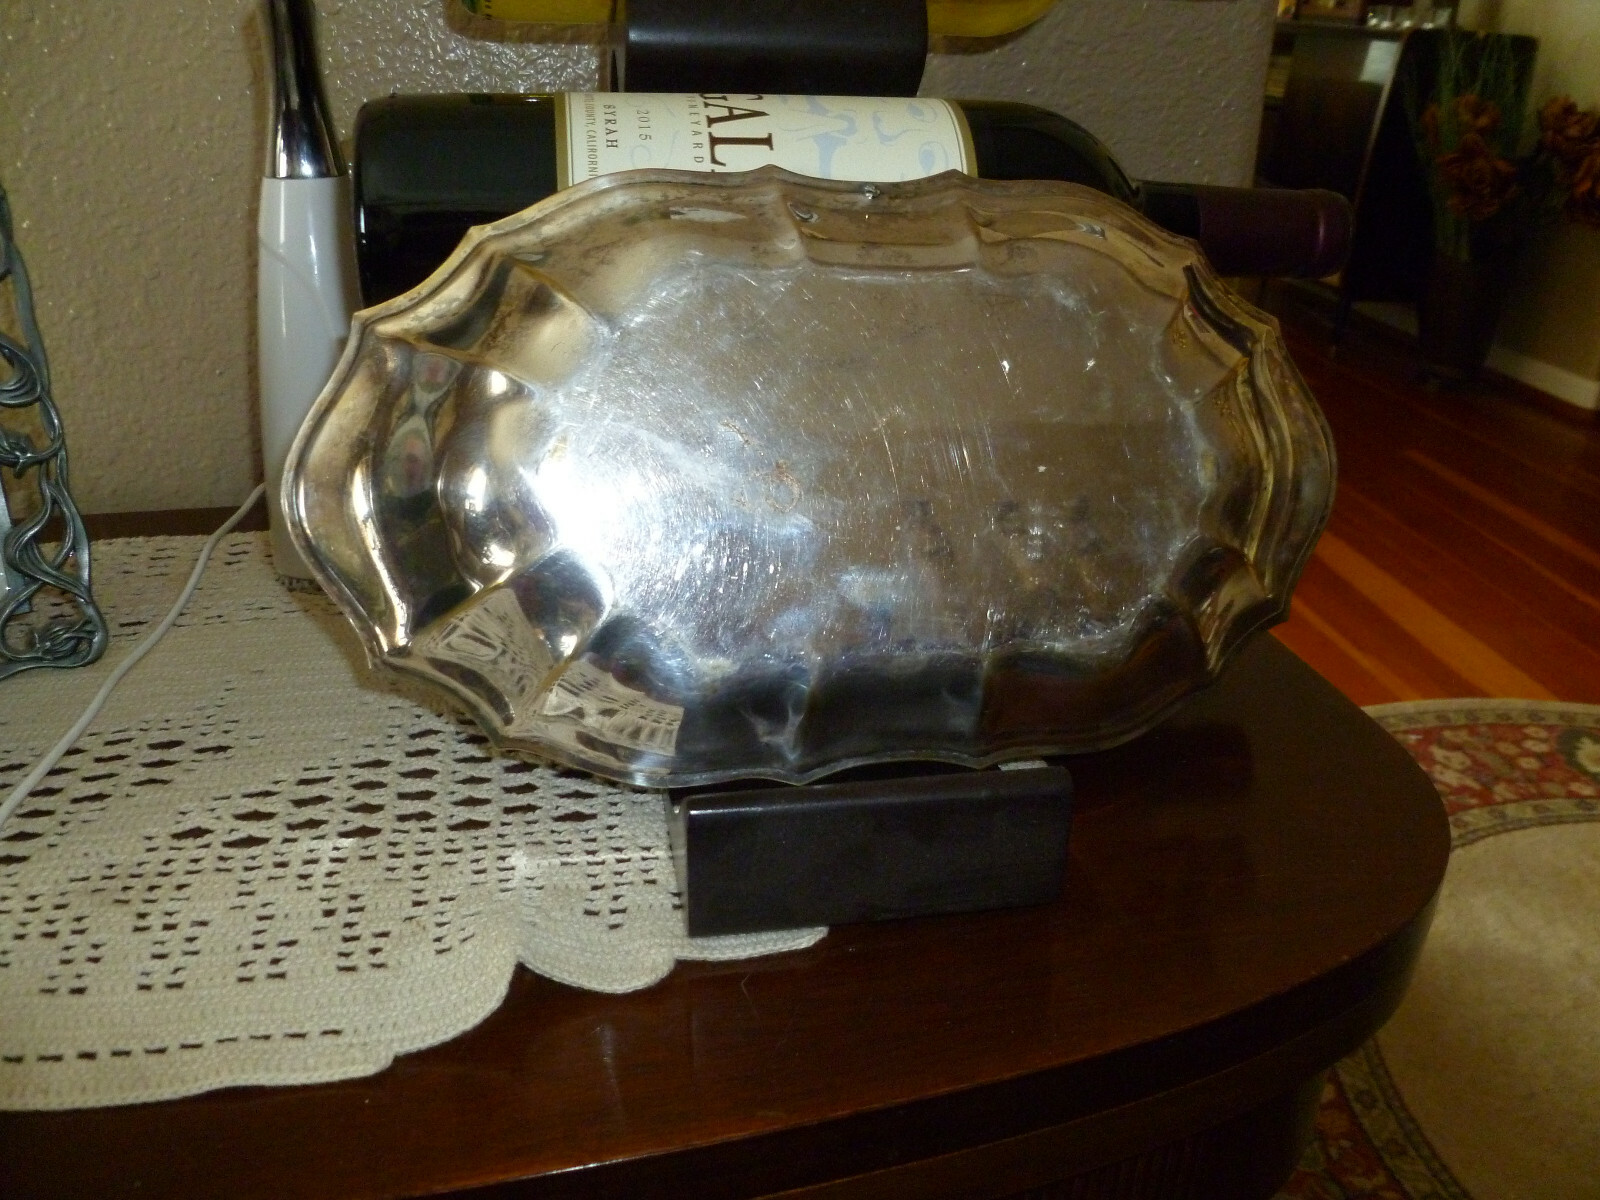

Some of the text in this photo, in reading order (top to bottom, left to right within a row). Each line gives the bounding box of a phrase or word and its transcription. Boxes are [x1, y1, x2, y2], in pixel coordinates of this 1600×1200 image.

[603, 104, 619, 149] SYRAH
[636, 109, 652, 141] 2015
[699, 93, 774, 173] GAL
